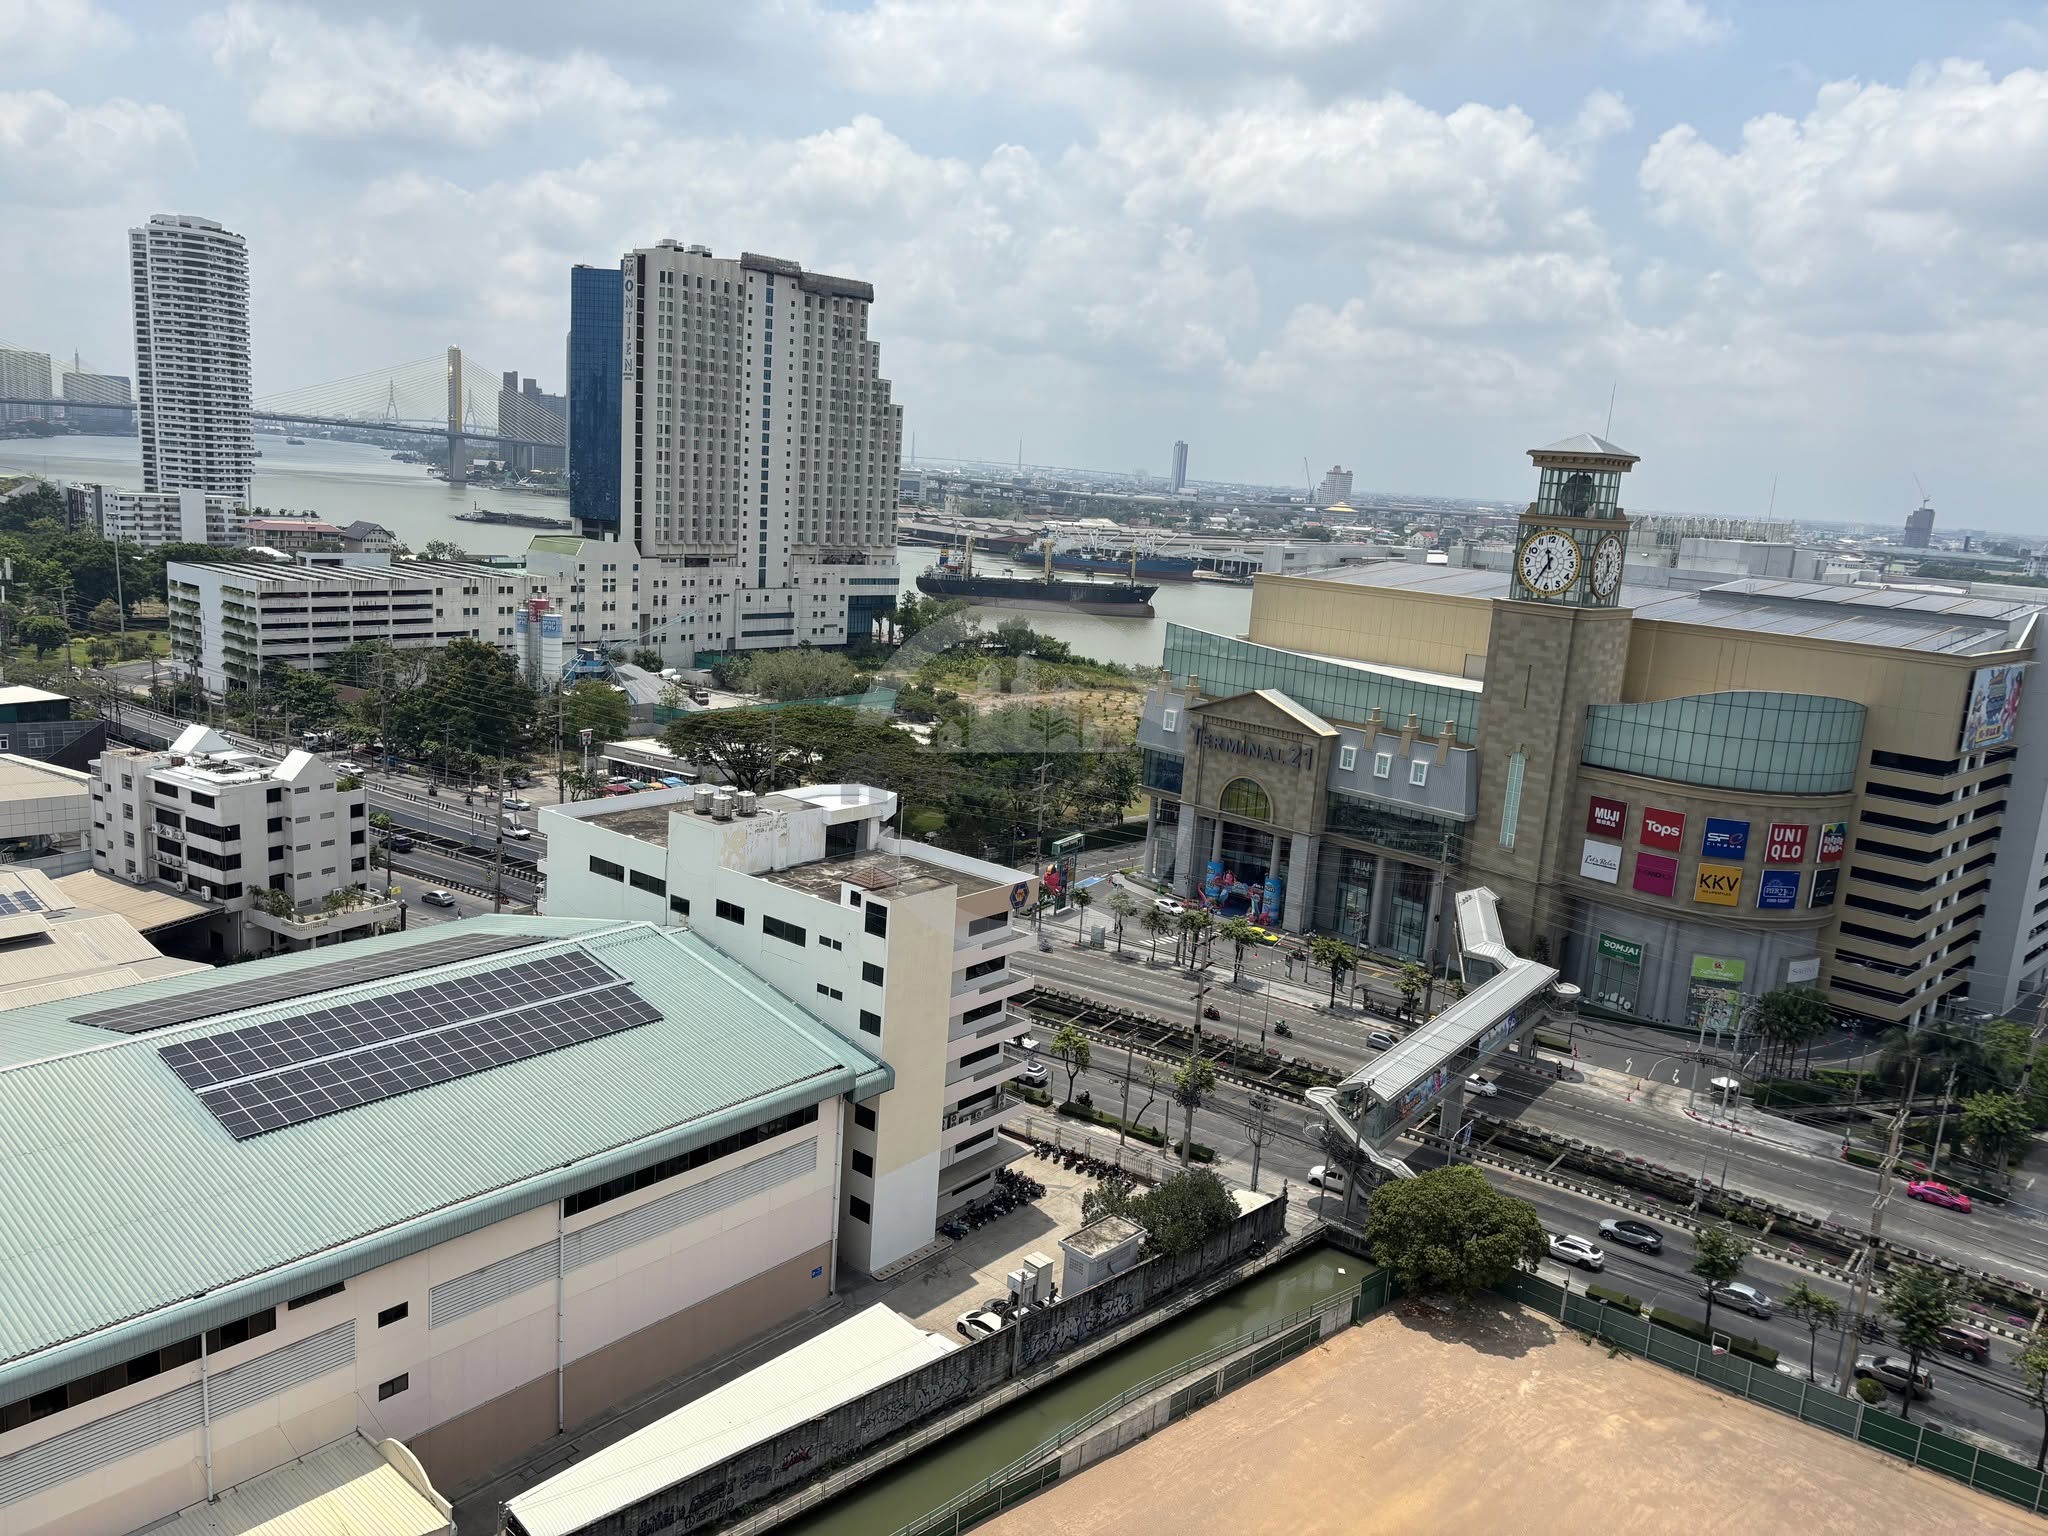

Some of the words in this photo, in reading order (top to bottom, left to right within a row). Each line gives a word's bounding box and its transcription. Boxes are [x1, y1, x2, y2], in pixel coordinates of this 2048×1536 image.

[1548, 535, 1556, 543] 12
[1528, 547, 1538, 555] 10
[1525, 557, 1531, 565] 9
[1569, 561, 1574, 569] 3
[1526, 569, 1531, 577] 8
[1543, 582, 1549, 590] 6
[1555, 580, 1560, 588] 5
[1193, 727, 1286, 765] TERMINAL
[1287, 744, 1313, 771] 21
[1594, 807, 1620, 822] MUJI
[1645, 819, 1680, 837] Tops
[1774, 828, 1802, 842] UNI
[1770, 845, 1801, 860] QLO
[1604, 940, 1639, 956] SOMJAI
